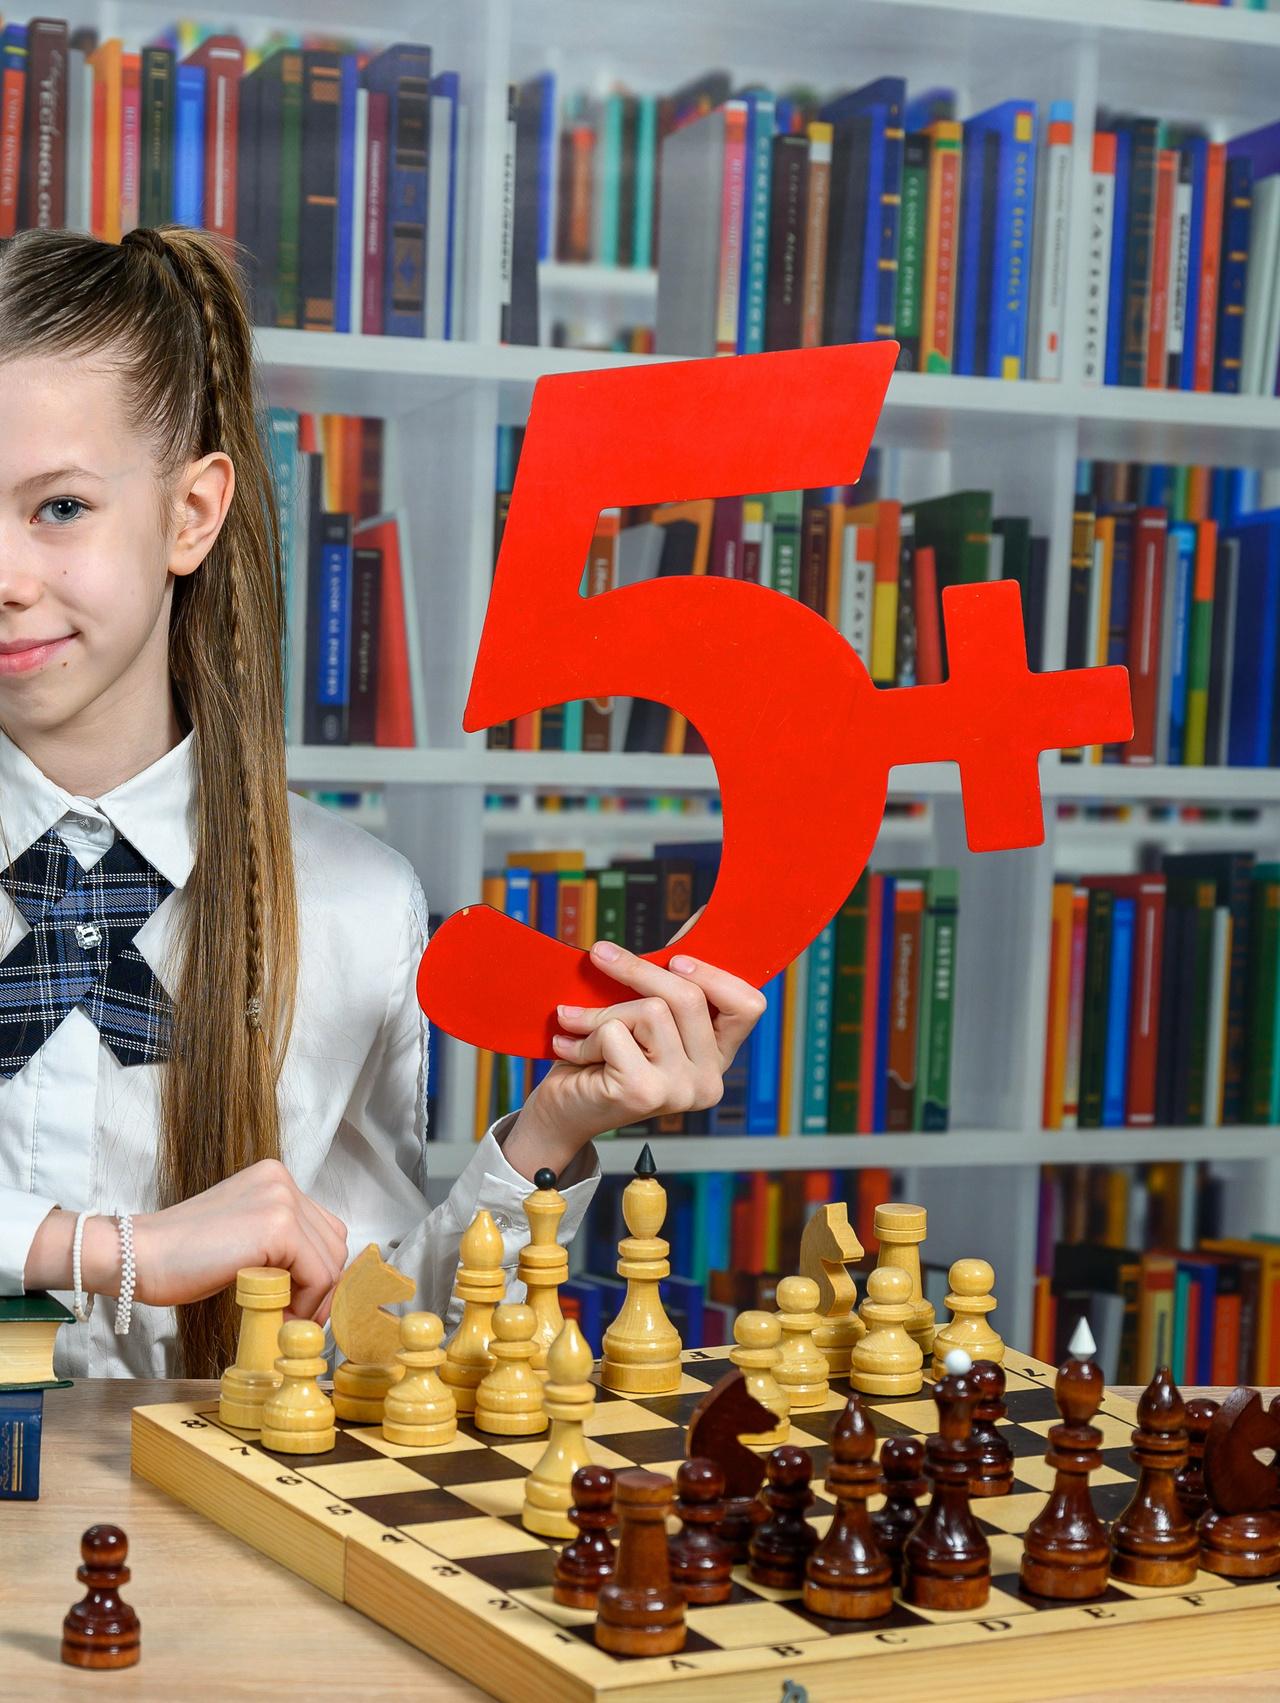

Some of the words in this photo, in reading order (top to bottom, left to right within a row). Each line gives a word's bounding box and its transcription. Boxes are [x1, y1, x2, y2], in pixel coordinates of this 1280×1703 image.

[1084, 181, 1106, 379] STATISTICS
[418, 341, 1134, 1060] 5+
[895, 932, 913, 1032] Literature
[688, 1351, 715, 1360] F
[180, 1419, 208, 1430] 8
[229, 1446, 251, 1456] 7
[276, 1474, 303, 1487] 6
[325, 1504, 353, 1517] 5
[381, 1533, 409, 1545] 4
[432, 1565, 462, 1578] 3
[488, 1598, 520, 1612] 2
[553, 1632, 576, 1645] 1
[670, 1658, 699, 1672] A
[769, 1645, 805, 1659] B
[875, 1631, 909, 1645] C
[976, 1619, 1012, 1632] D
[1081, 1606, 1117, 1620] E
[1179, 1594, 1206, 1607] F
